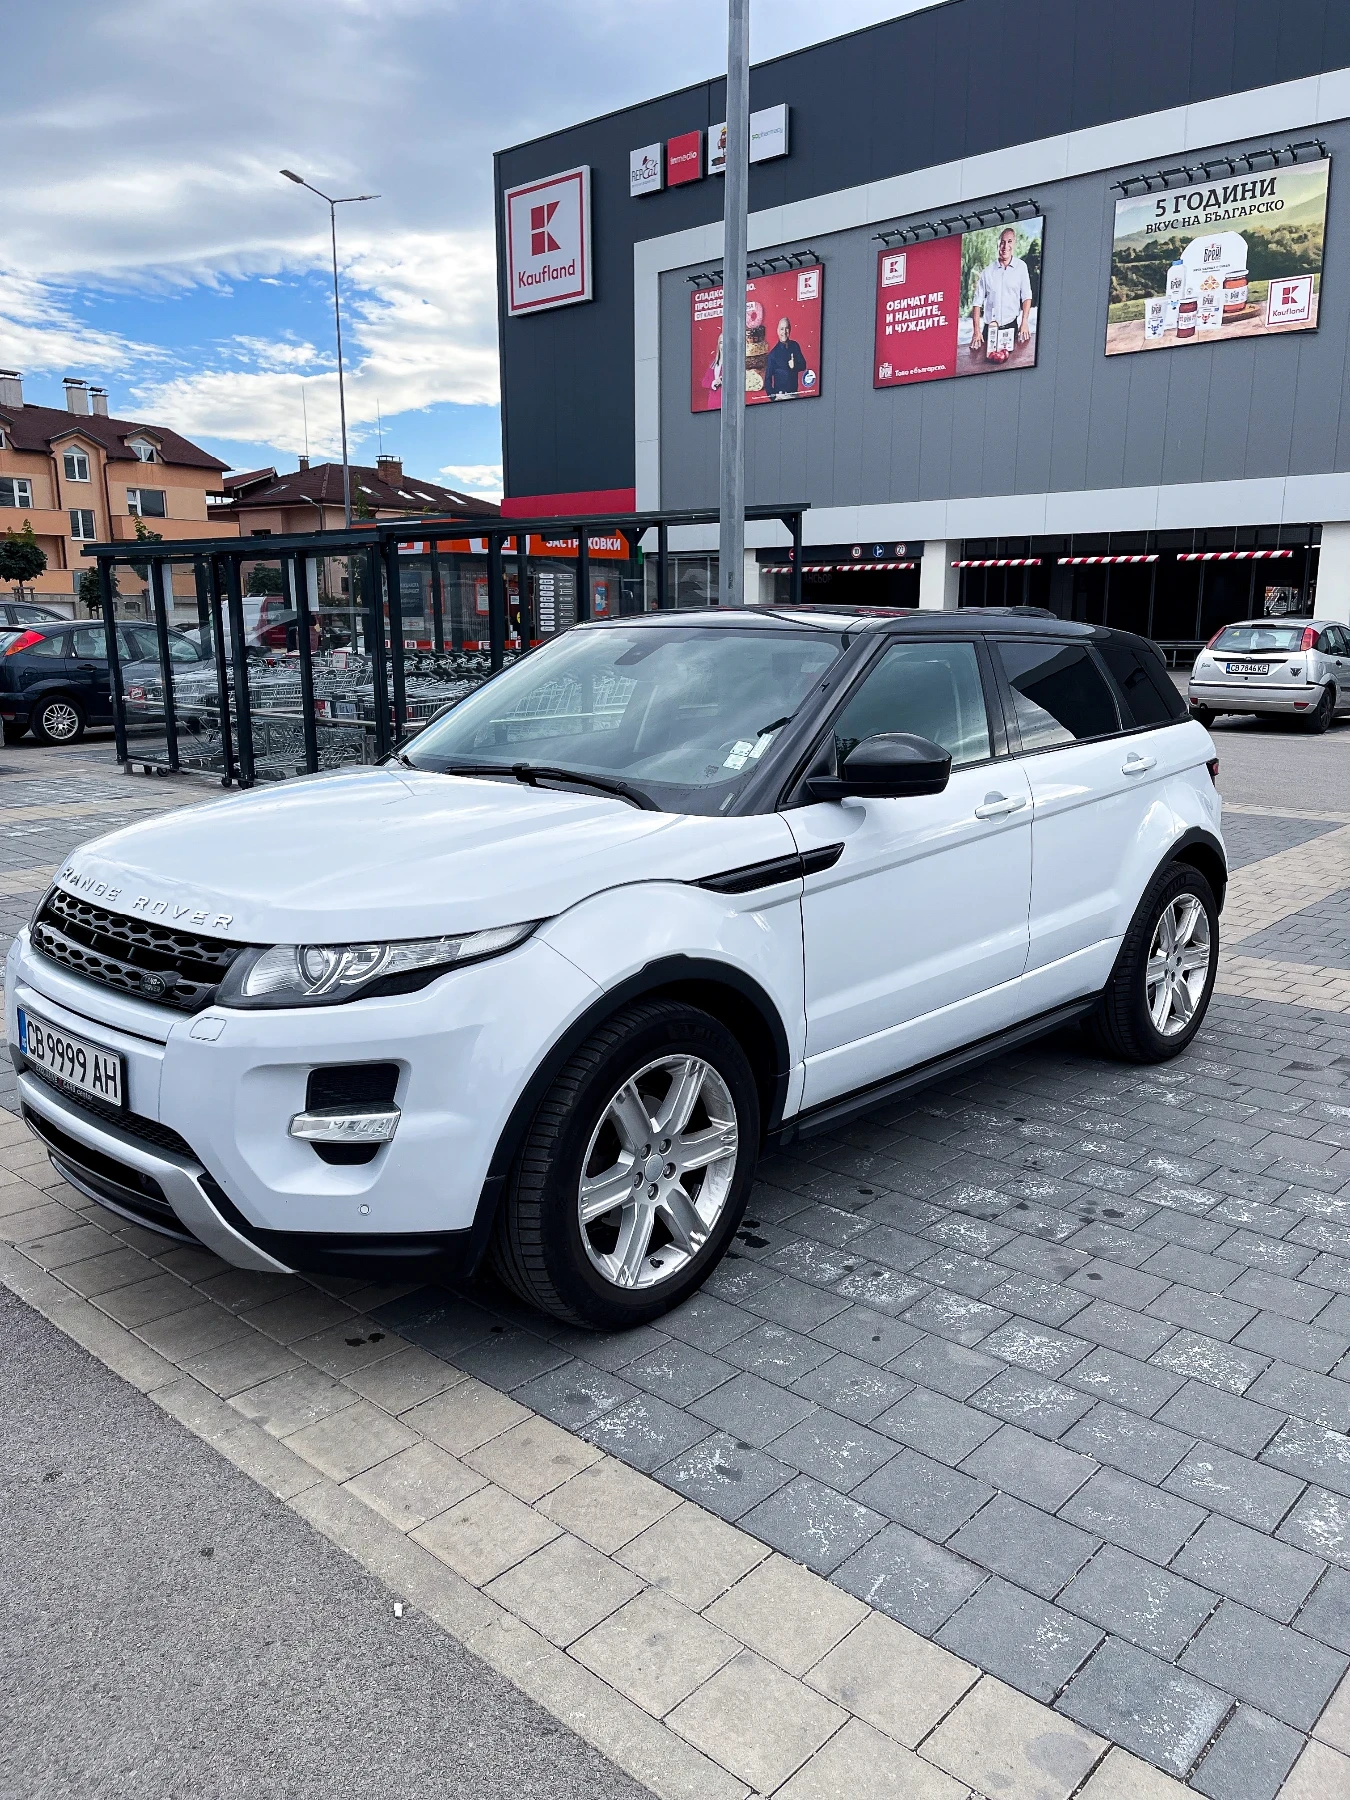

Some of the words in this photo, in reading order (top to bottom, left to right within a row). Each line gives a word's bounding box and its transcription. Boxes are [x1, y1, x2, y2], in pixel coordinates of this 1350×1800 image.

[1155, 198, 1167, 218] 5
[1172, 177, 1277, 214] ГОДИНИ
[1145, 219, 1179, 234] ВКУС
[1181, 215, 1201, 228] НА
[1204, 199, 1285, 224] БЪЛГАРСКО
[518, 258, 576, 289] Kaufland
[886, 294, 926, 311] ОБИЧАТ
[928, 292, 944, 304] МЕ
[1272, 305, 1306, 317] Kaufland
[885, 313, 893, 323] И
[895, 305, 942, 322] НАШИТЕ,
[885, 325, 893, 335] И
[894, 316, 948, 334] ЧУЖДИТЕ.
[545, 536, 621, 551] ЗАСТРХОВКИ
[1240, 664, 1257, 672] 7846
[1257, 665, 1267, 673] KE
[62, 866, 122, 902] RANGE
[132, 895, 234, 931] ROVER
[27, 1020, 45, 1061] CB
[46, 1032, 87, 1083] 9999
[92, 1053, 118, 1098] AH
